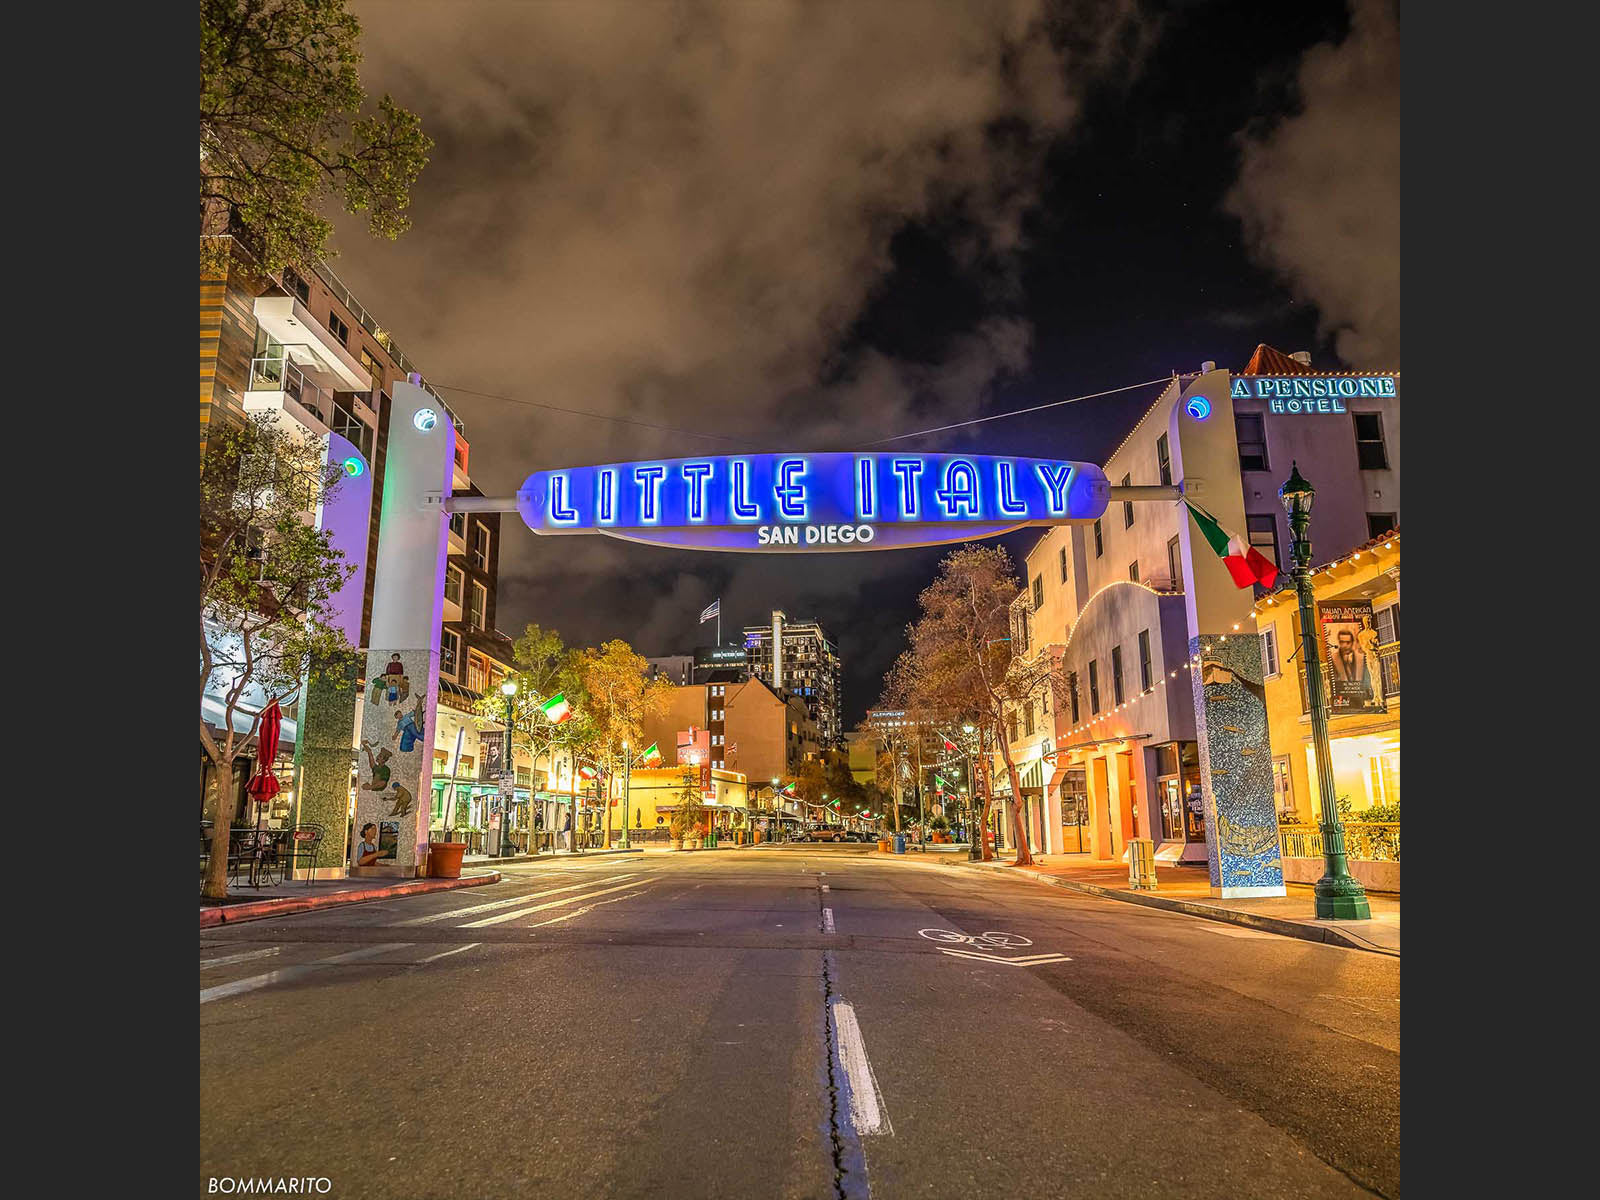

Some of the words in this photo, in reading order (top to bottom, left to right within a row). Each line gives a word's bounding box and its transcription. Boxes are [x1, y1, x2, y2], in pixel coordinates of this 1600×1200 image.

[1231, 378, 1250, 398] A
[1256, 377, 1396, 398] PENSIONE
[1270, 399, 1346, 414] HOTEL
[549, 458, 807, 523] LITTLE
[859, 457, 1074, 517] ITALY
[758, 525, 801, 545] SAN
[805, 524, 875, 544] DIEGO
